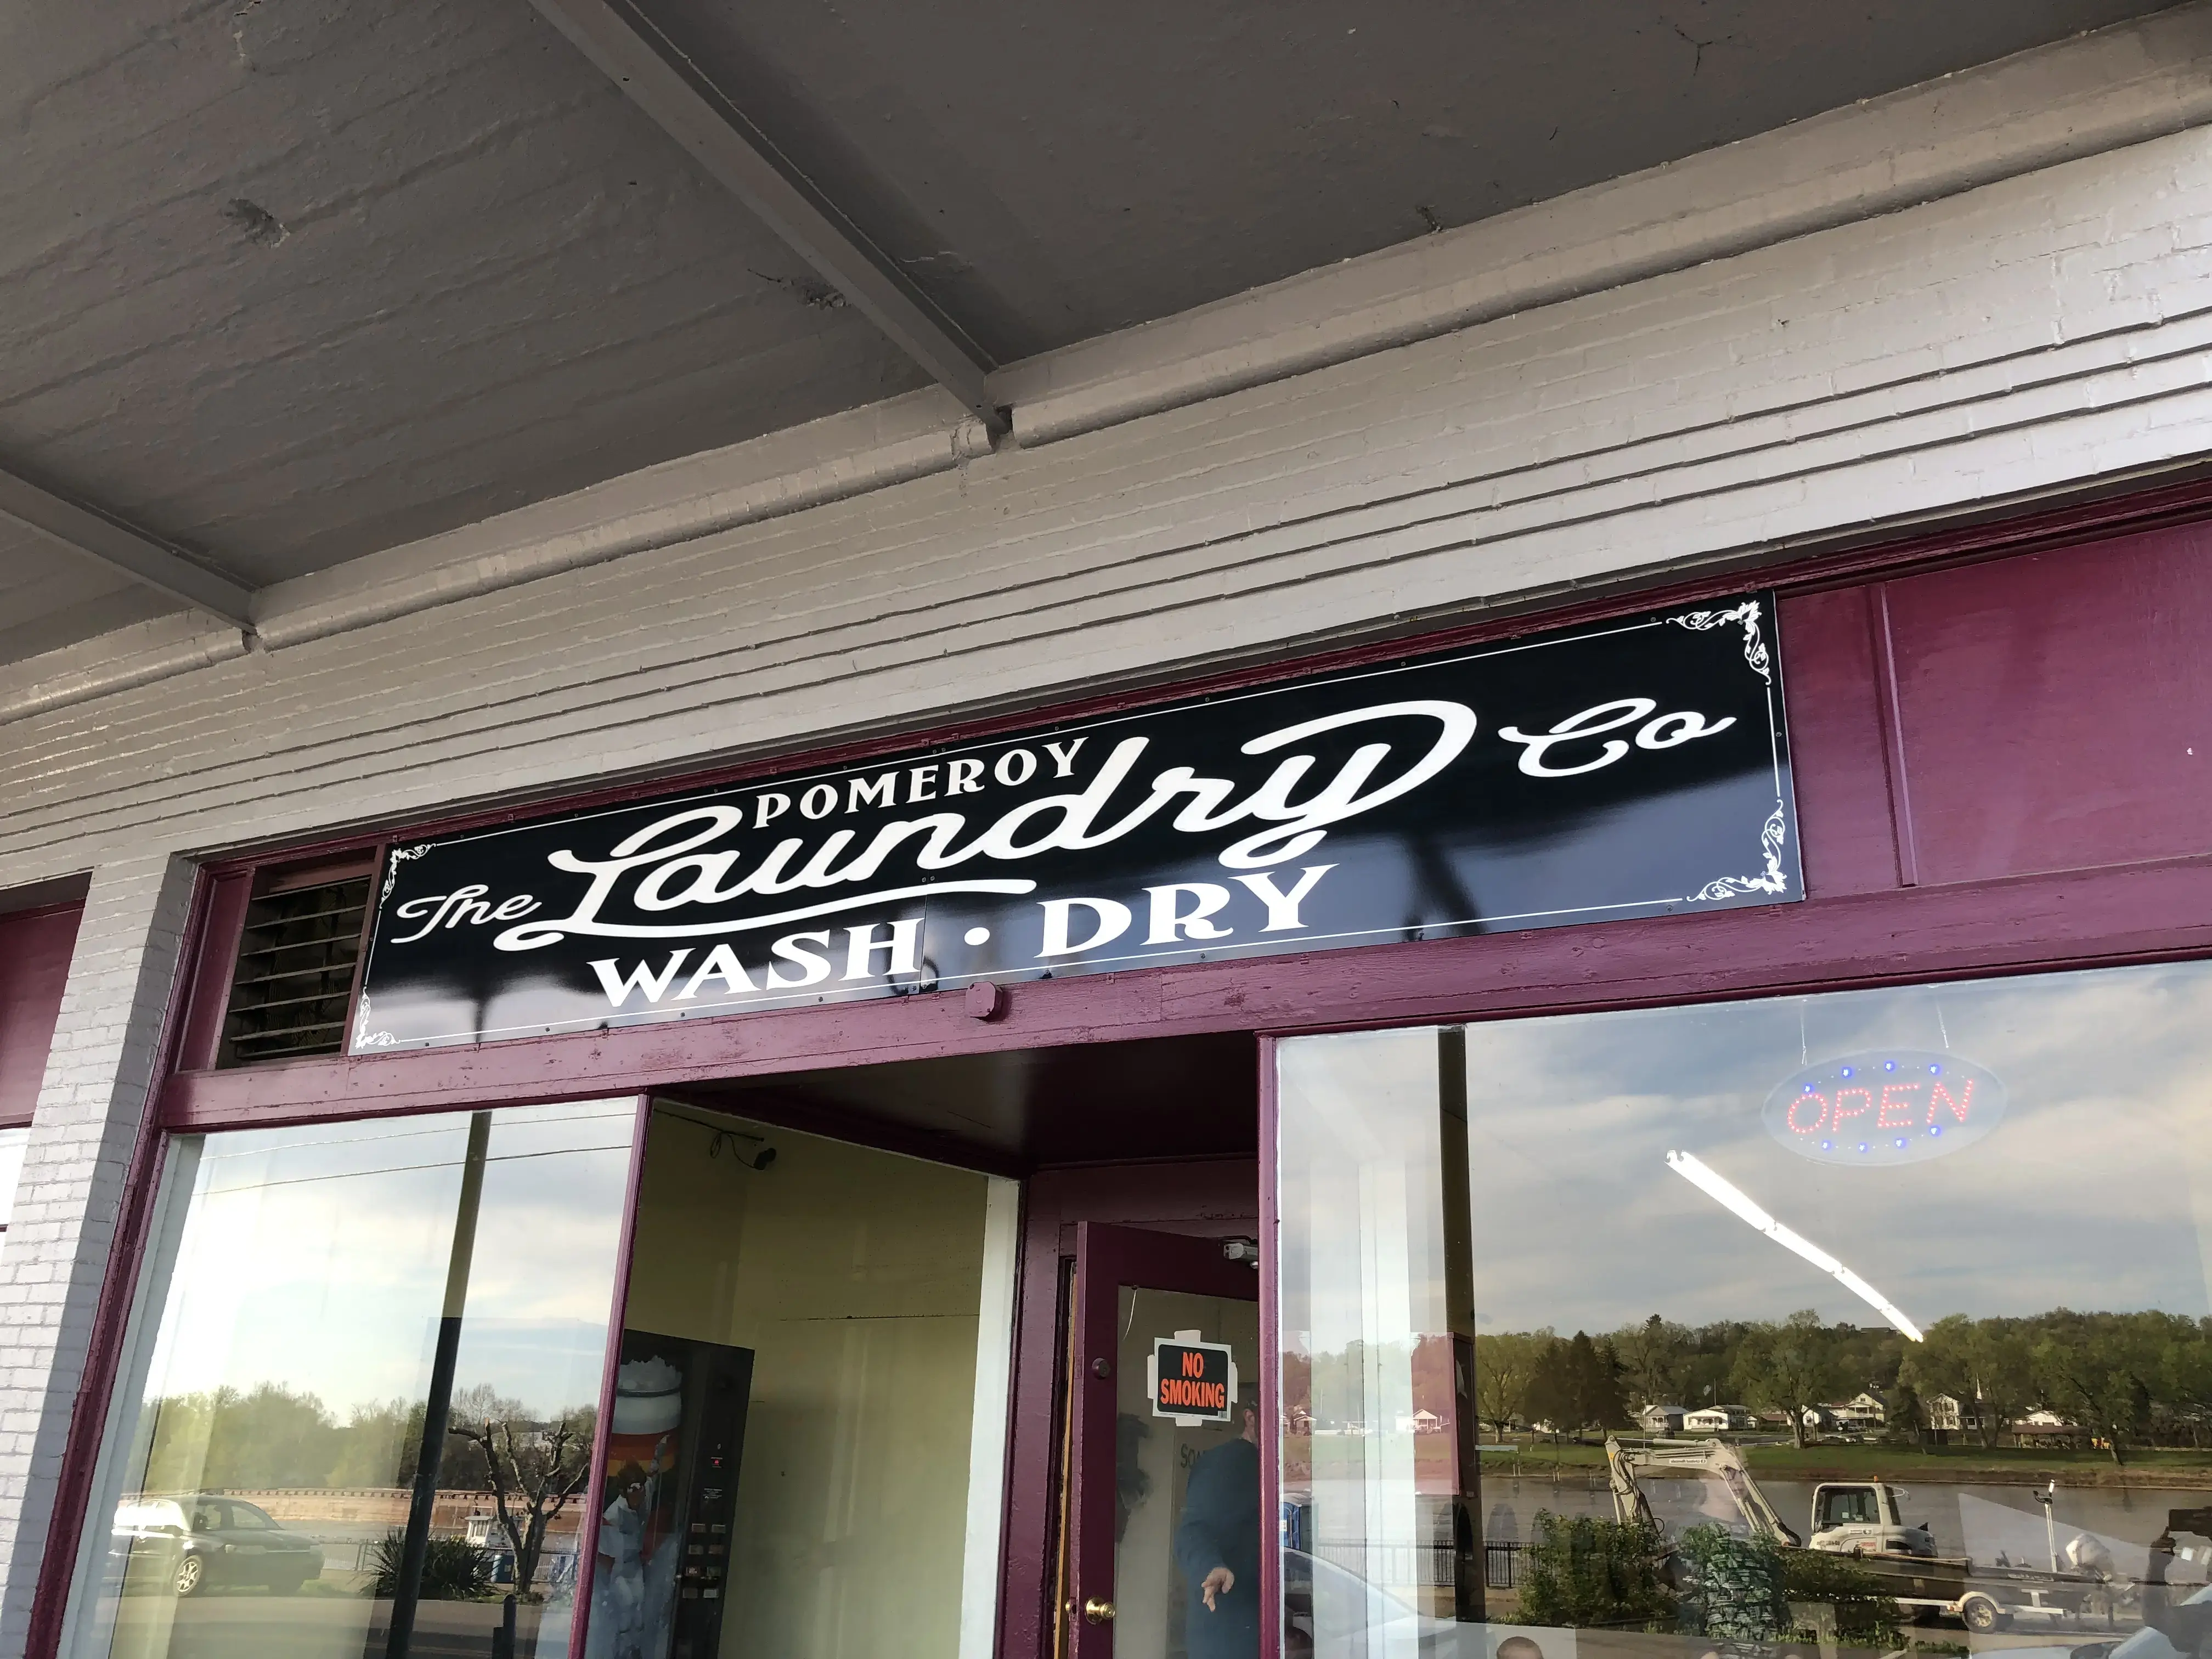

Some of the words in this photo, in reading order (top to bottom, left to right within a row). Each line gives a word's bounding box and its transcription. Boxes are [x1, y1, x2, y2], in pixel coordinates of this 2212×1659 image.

[752, 737, 1089, 829] POMEROY
[390, 884, 543, 944] The
[493, 700, 1477, 951] Laundry
[1497, 697, 1737, 777] Co
[586, 917, 926, 1007] WASH
[1032, 863, 1341, 958] DRY
[1786, 1079, 1973, 1134] OPEN
[1160, 1378, 1225, 1409] SMOKING
[1182, 1351, 1204, 1379] NO
